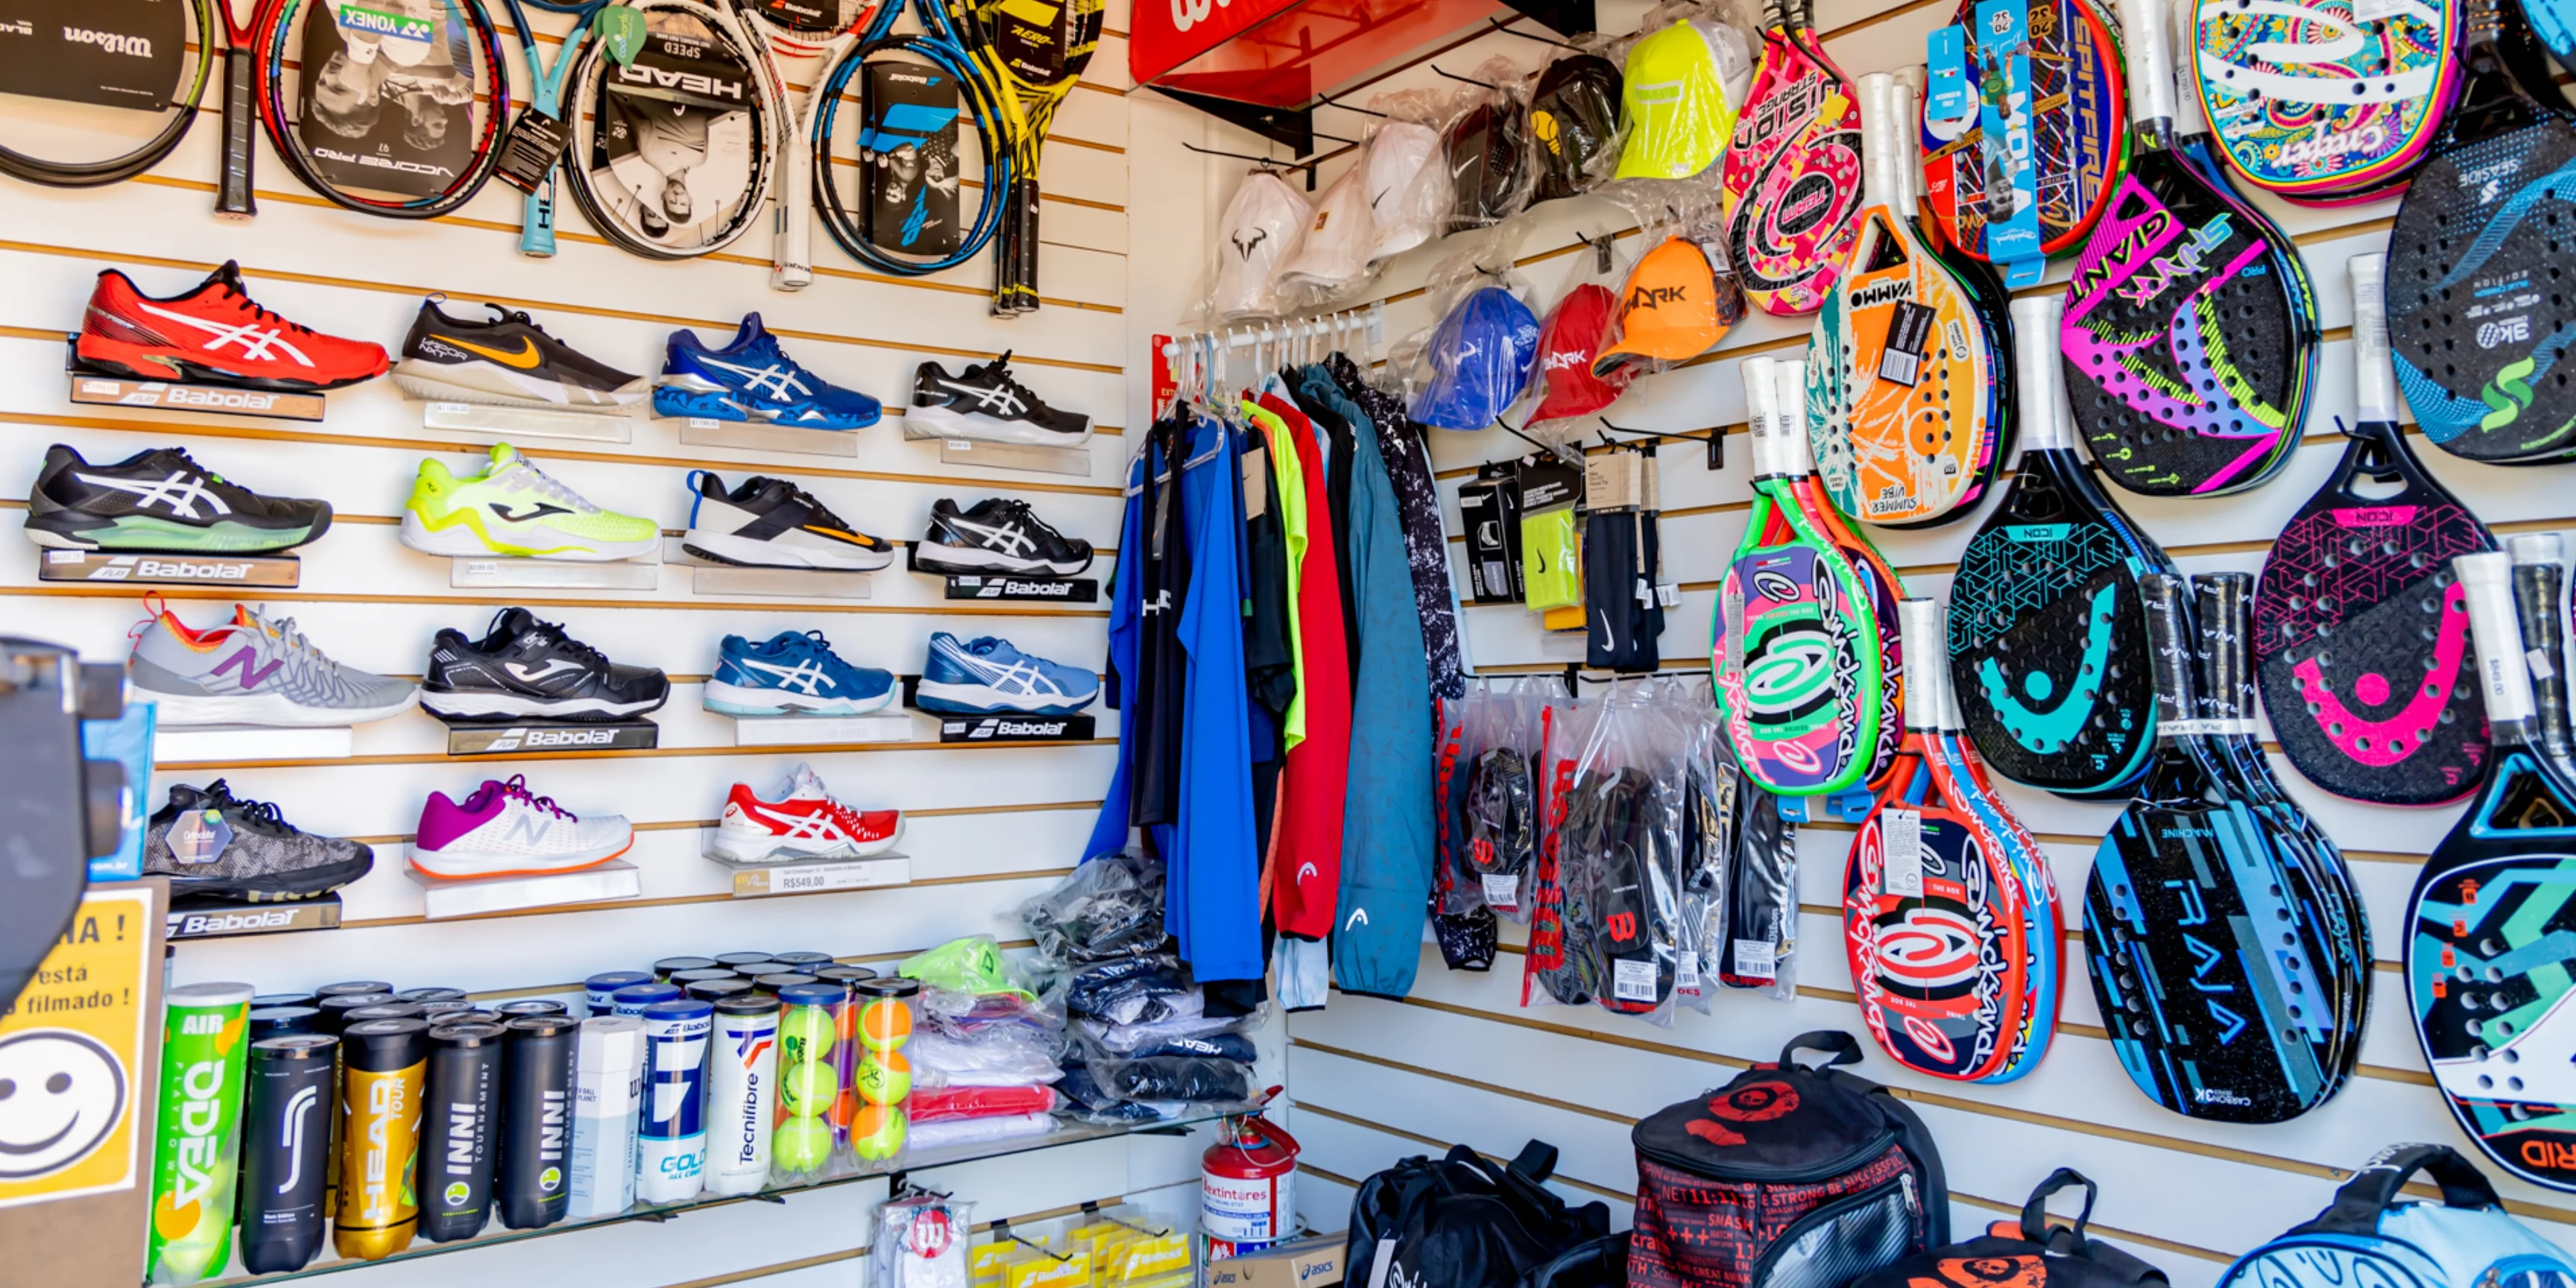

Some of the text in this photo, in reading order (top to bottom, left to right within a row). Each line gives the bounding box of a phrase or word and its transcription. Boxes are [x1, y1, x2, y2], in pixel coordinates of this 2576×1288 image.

[345, 9, 397, 33] YONEX
[63, 26, 152, 58] Wilson
[664, 43, 701, 59] SPEED
[619, 64, 742, 100] HEAD
[1756, 71, 1816, 118] STRANGE
[2072, 15, 2100, 212] SPITFIRE
[314, 147, 455, 178] VCORE PRO
[2458, 158, 2519, 188] SEASIDE
[1782, 188, 1826, 224] TEAM
[2069, 209, 2171, 312] GIANT
[2241, 264, 2266, 277] PRO
[1881, 486, 1905, 499] VIBE
[1871, 497, 1917, 514] SUMMER
[2355, 510, 2394, 523] ICON
[2024, 526, 2053, 539] ICON
[2161, 828, 2214, 839] MACHINE
[1531, 759, 1578, 974] Wilson
[783, 876, 824, 889] R$549,00
[1933, 883, 1960, 894] THE BOX
[39, 964, 88, 985] está
[1739, 974, 1775, 987] SHOES
[27, 989, 113, 1014] filmado
[1678, 988, 1700, 996] OES
[1890, 997, 1916, 1008] THE BOX
[181, 1014, 224, 1035] AIR
[1945, 1010, 1966, 1020] THINK
[682, 1022, 710, 1032] Babol
[1168, 1035, 1222, 1055] HEAD
[390, 1077, 405, 1121] TOUR
[564, 1049, 575, 1148] TOURNAMENT
[2194, 1087, 2252, 1106] CARBON 3K
[474, 1062, 490, 1163] TOURNAMENT
[738, 1073, 759, 1165] Tecnifibre
[174, 1059, 225, 1210] ODEA
[540, 1090, 565, 1161] INNI
[446, 1102, 477, 1175] INNI
[362, 1079, 390, 1220] HEAD
[1772, 1155, 1903, 1206] STRONG BE SUCCESSFUL
[1661, 1185, 1740, 1207] NET 11:11
[1708, 1213, 1754, 1232] SMASH
[1710, 1231, 1733, 1240] MATCH
[1220, 1273, 1236, 1284] asics
[1311, 1261, 1333, 1275] asics
